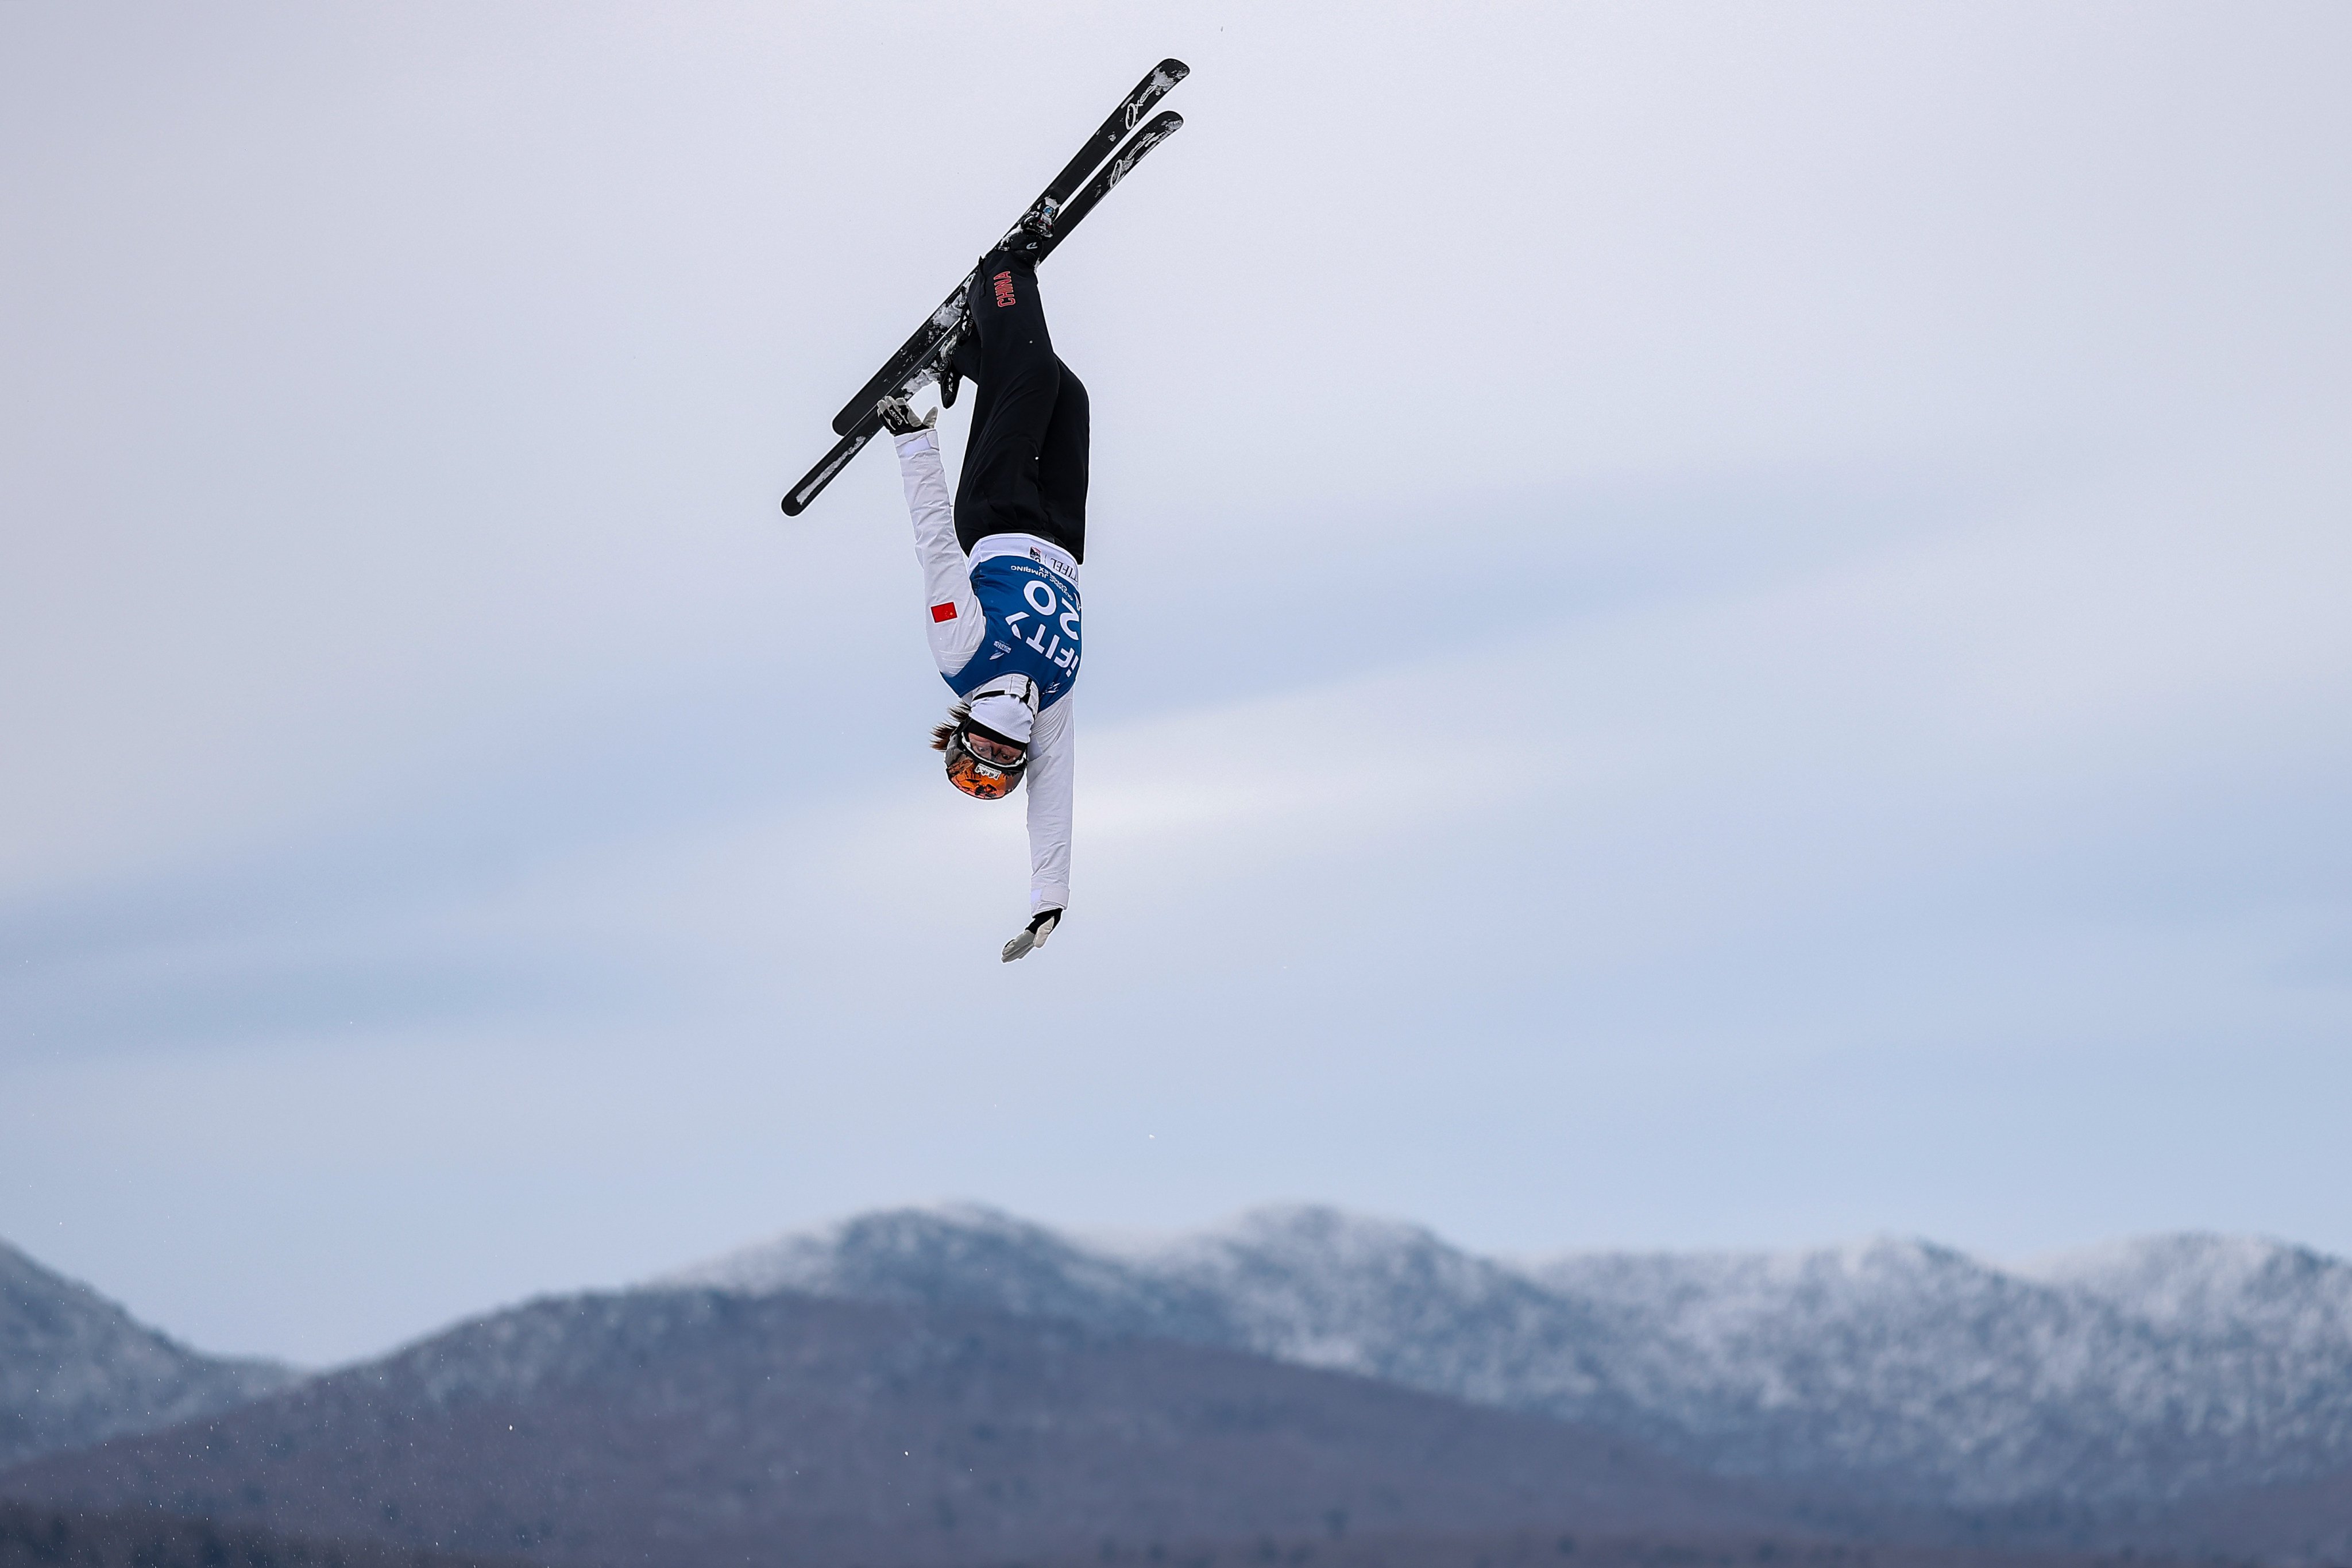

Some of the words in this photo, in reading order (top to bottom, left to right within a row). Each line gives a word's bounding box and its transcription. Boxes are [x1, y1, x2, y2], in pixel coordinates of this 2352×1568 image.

[993, 271, 1015, 307] CHINA
[1010, 565, 1048, 578] JUMPING
[1051, 558, 1078, 582] TIFEL
[1023, 580, 1079, 640] 20
